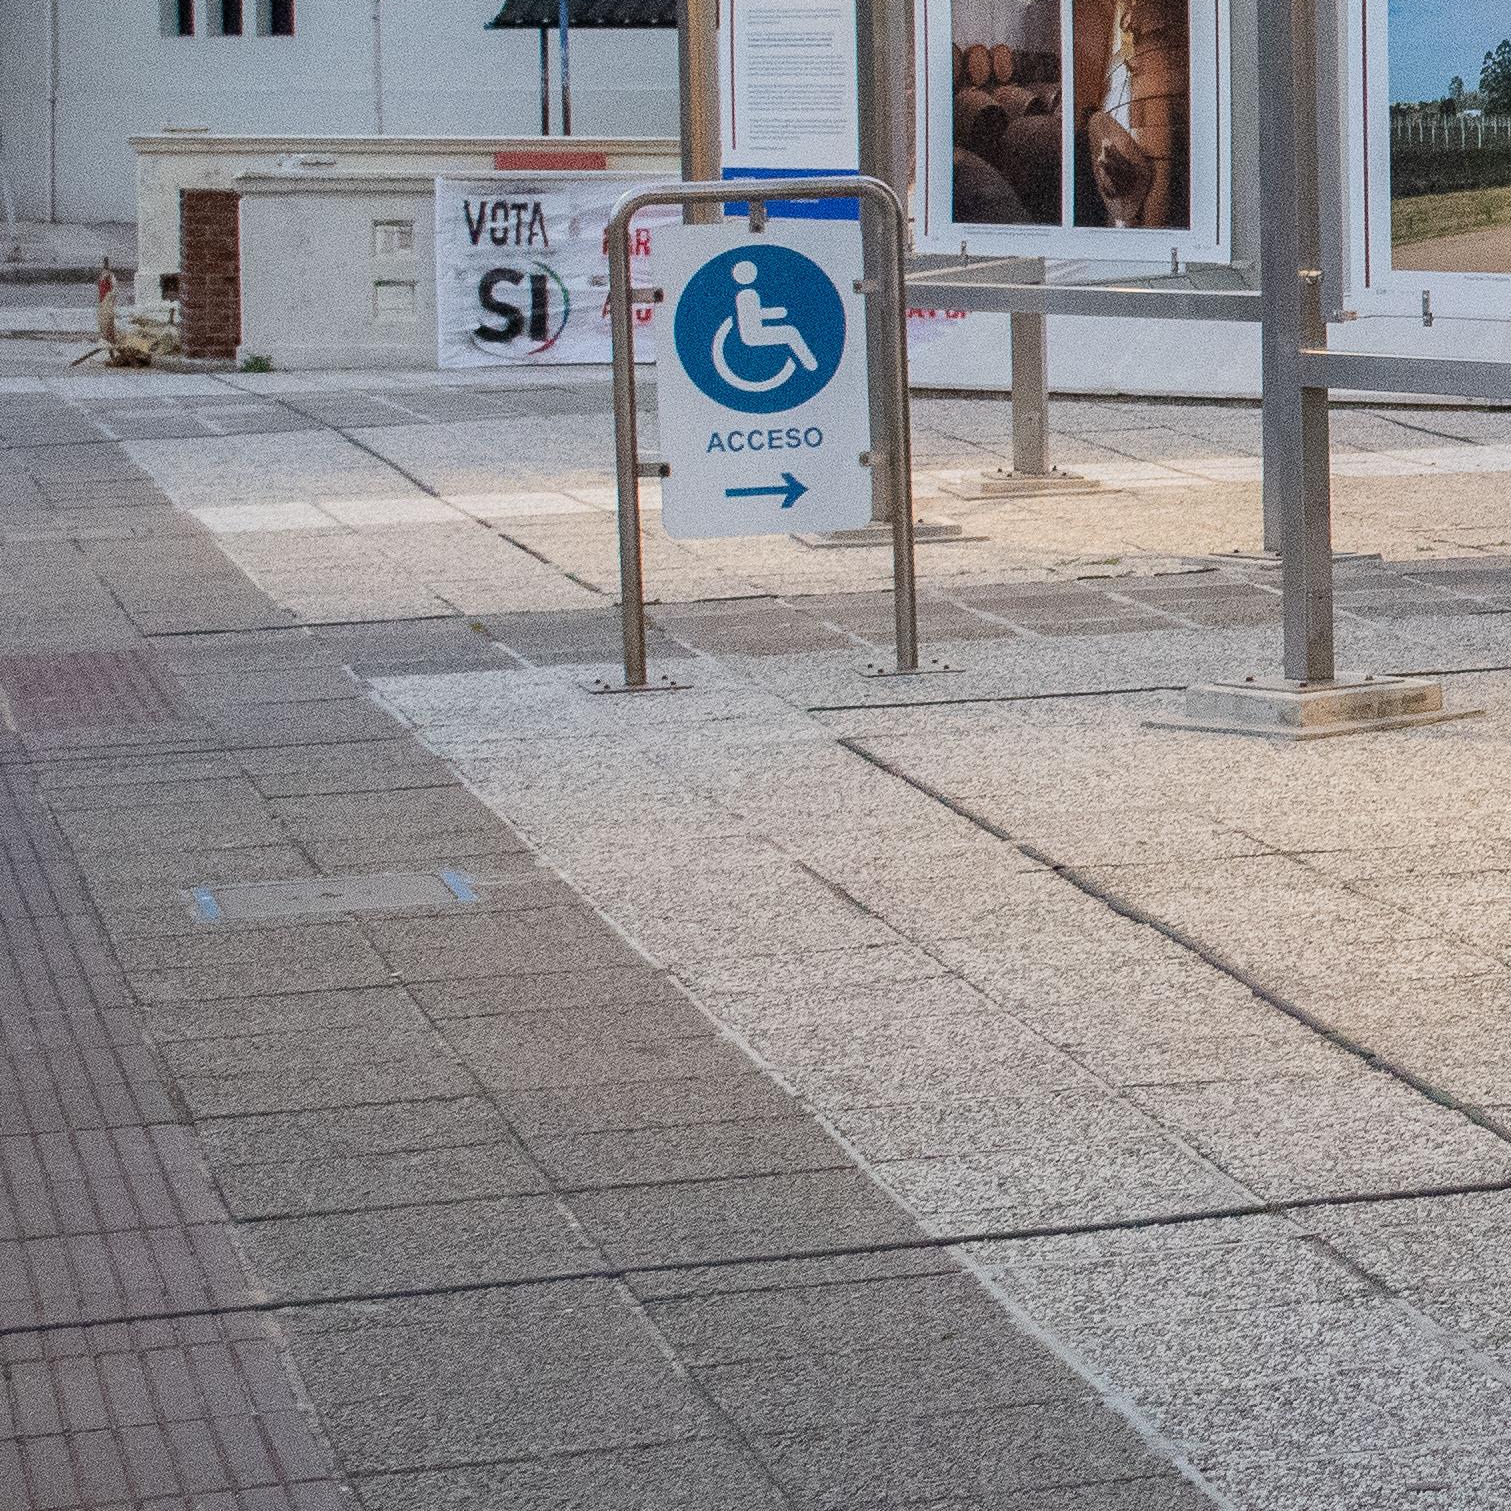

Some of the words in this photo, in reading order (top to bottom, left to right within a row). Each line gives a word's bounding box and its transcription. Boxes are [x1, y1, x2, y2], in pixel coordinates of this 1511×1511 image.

[463, 199, 550, 248] VOTA
[475, 266, 549, 343] SI
[706, 426, 824, 454] ACCESO
